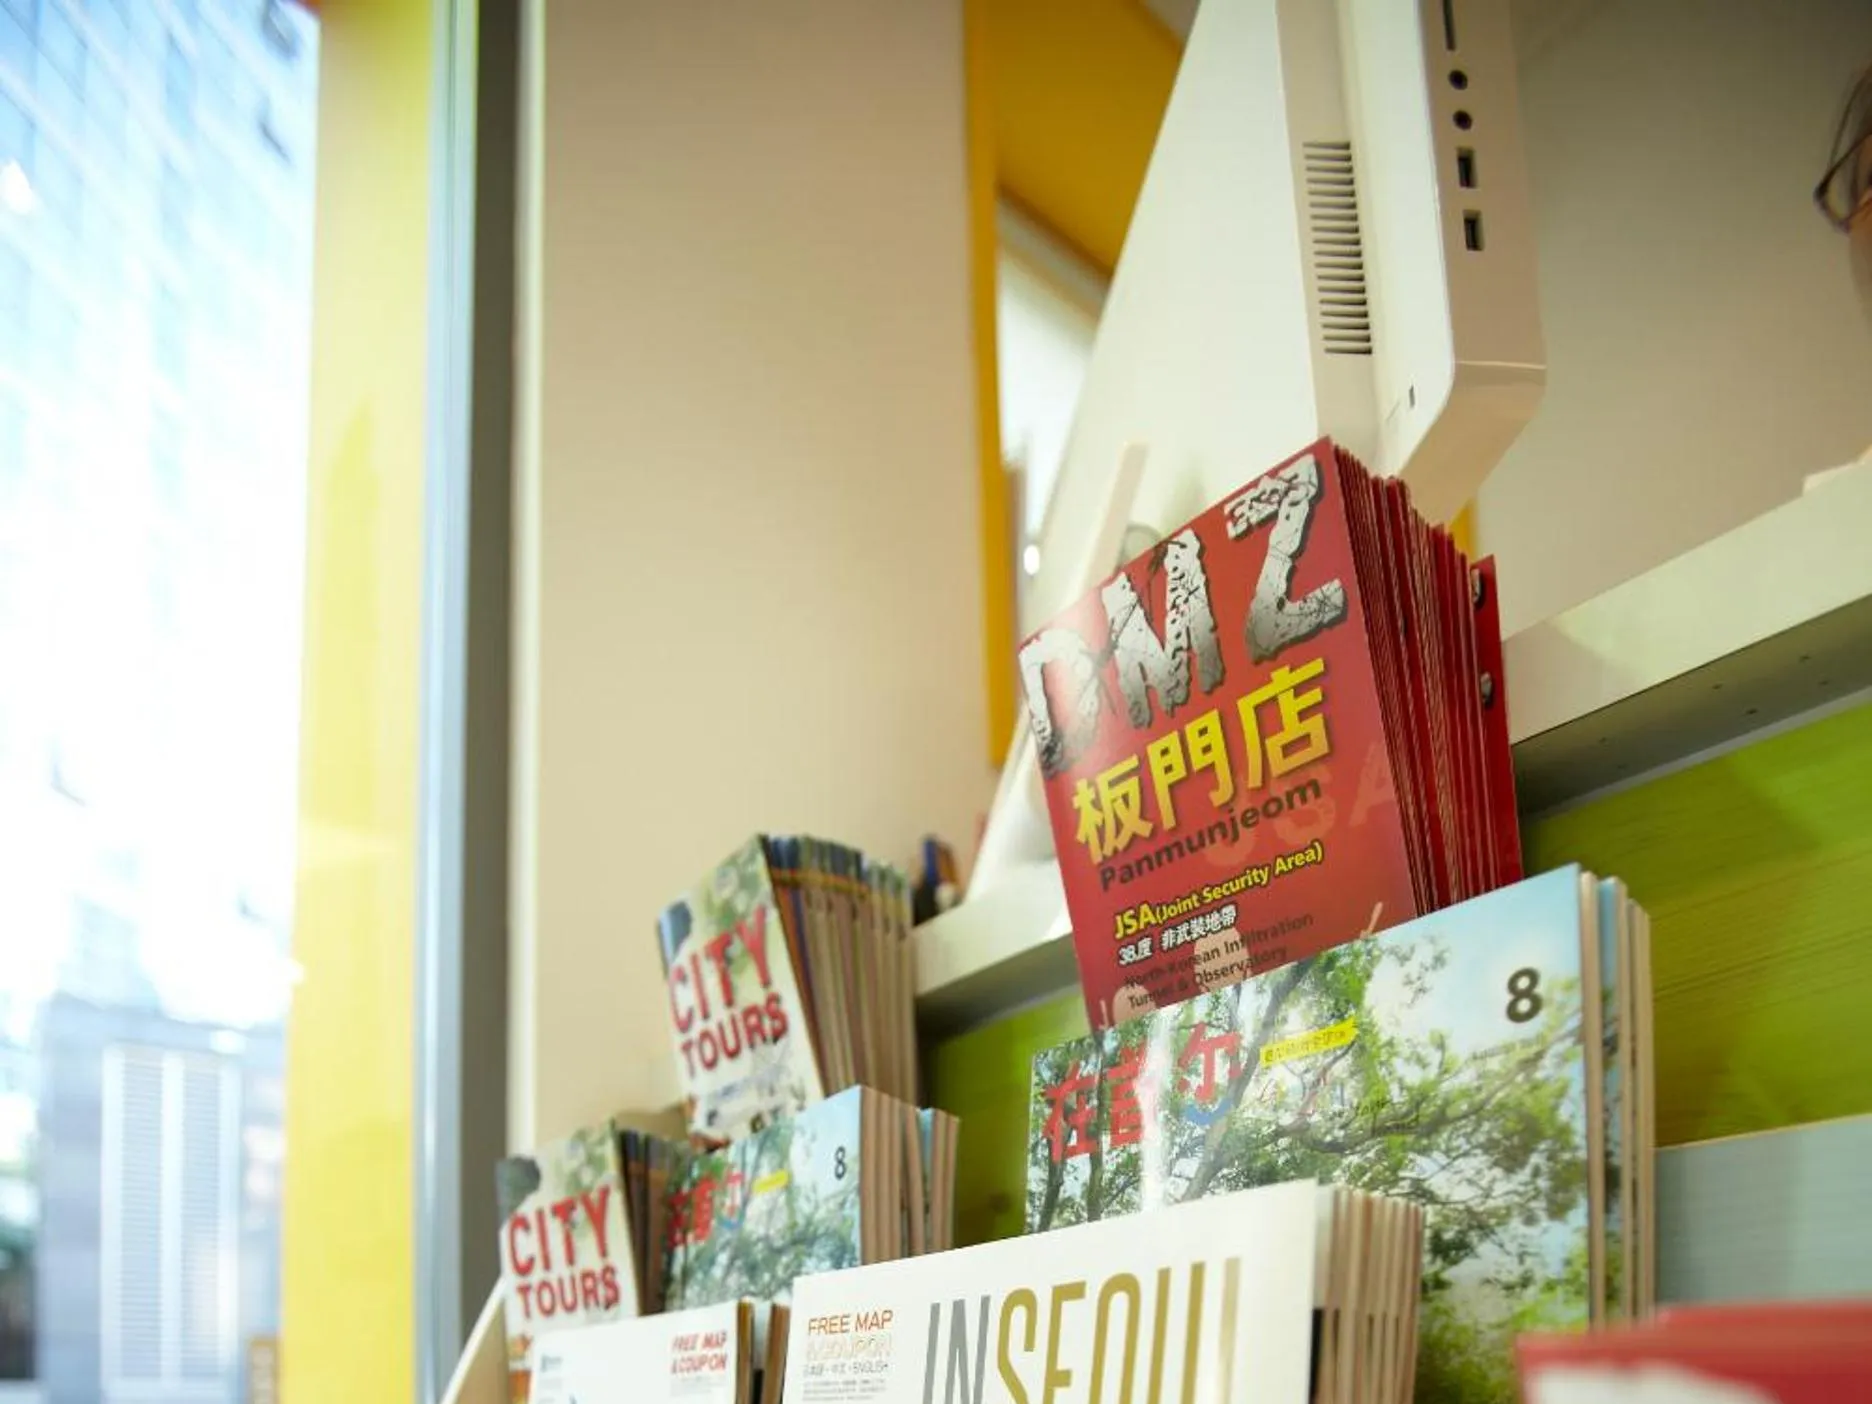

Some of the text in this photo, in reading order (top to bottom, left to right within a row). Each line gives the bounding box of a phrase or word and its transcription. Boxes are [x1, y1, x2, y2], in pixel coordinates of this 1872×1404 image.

[1019, 453, 1348, 778] DMZ
[1072, 658, 1331, 863] 板門店
[1101, 776, 1323, 891] Panmunjeom
[1202, 866, 1270, 901] Security
[1274, 841, 1324, 876] Area)
[1224, 914, 1314, 954] Infiltration
[668, 905, 773, 1034] CITY
[1195, 946, 1288, 986] Observatory
[1505, 968, 1543, 1024] 8
[681, 992, 789, 1078] TOURS
[834, 1146, 847, 1180] 8
[508, 1185, 612, 1276] CITY
[517, 1265, 622, 1319] TOURS
[808, 1310, 894, 1336] FREE MAP
